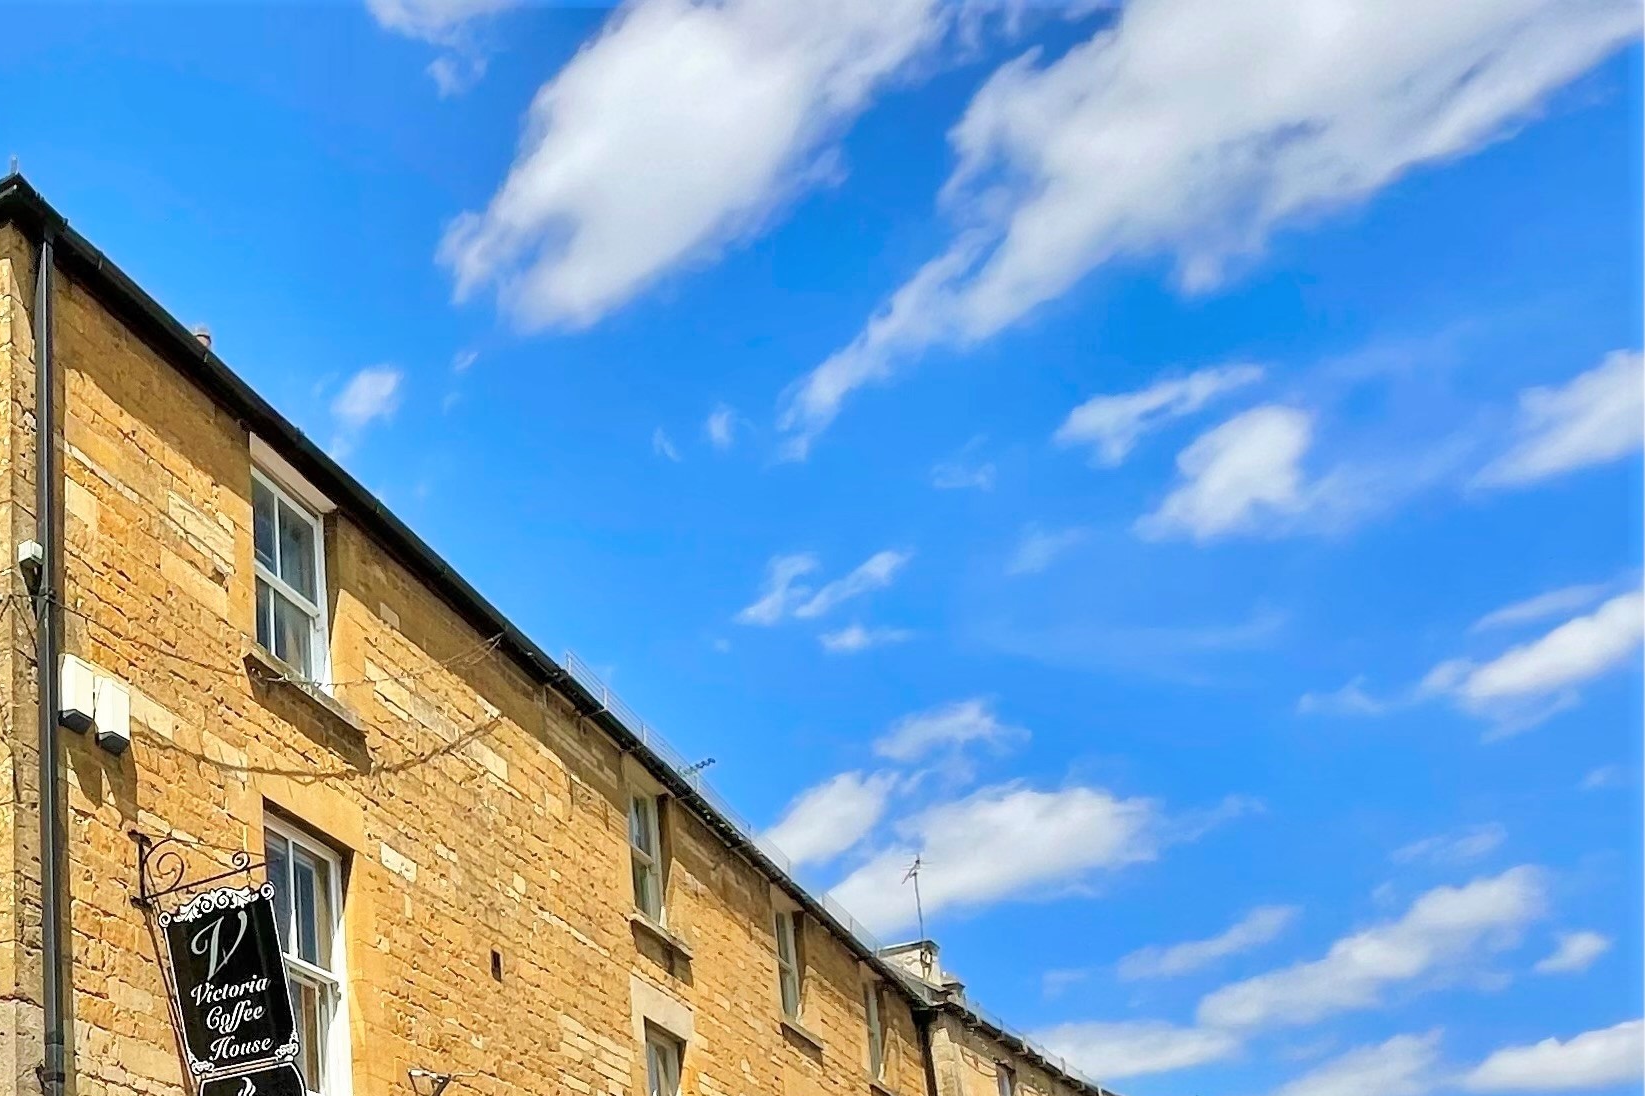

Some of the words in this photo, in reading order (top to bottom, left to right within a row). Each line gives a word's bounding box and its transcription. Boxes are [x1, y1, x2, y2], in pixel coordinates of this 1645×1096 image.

[190, 975, 271, 1007] Victoria
[206, 1000, 265, 1034] Coffee
[209, 1037, 275, 1061] House
